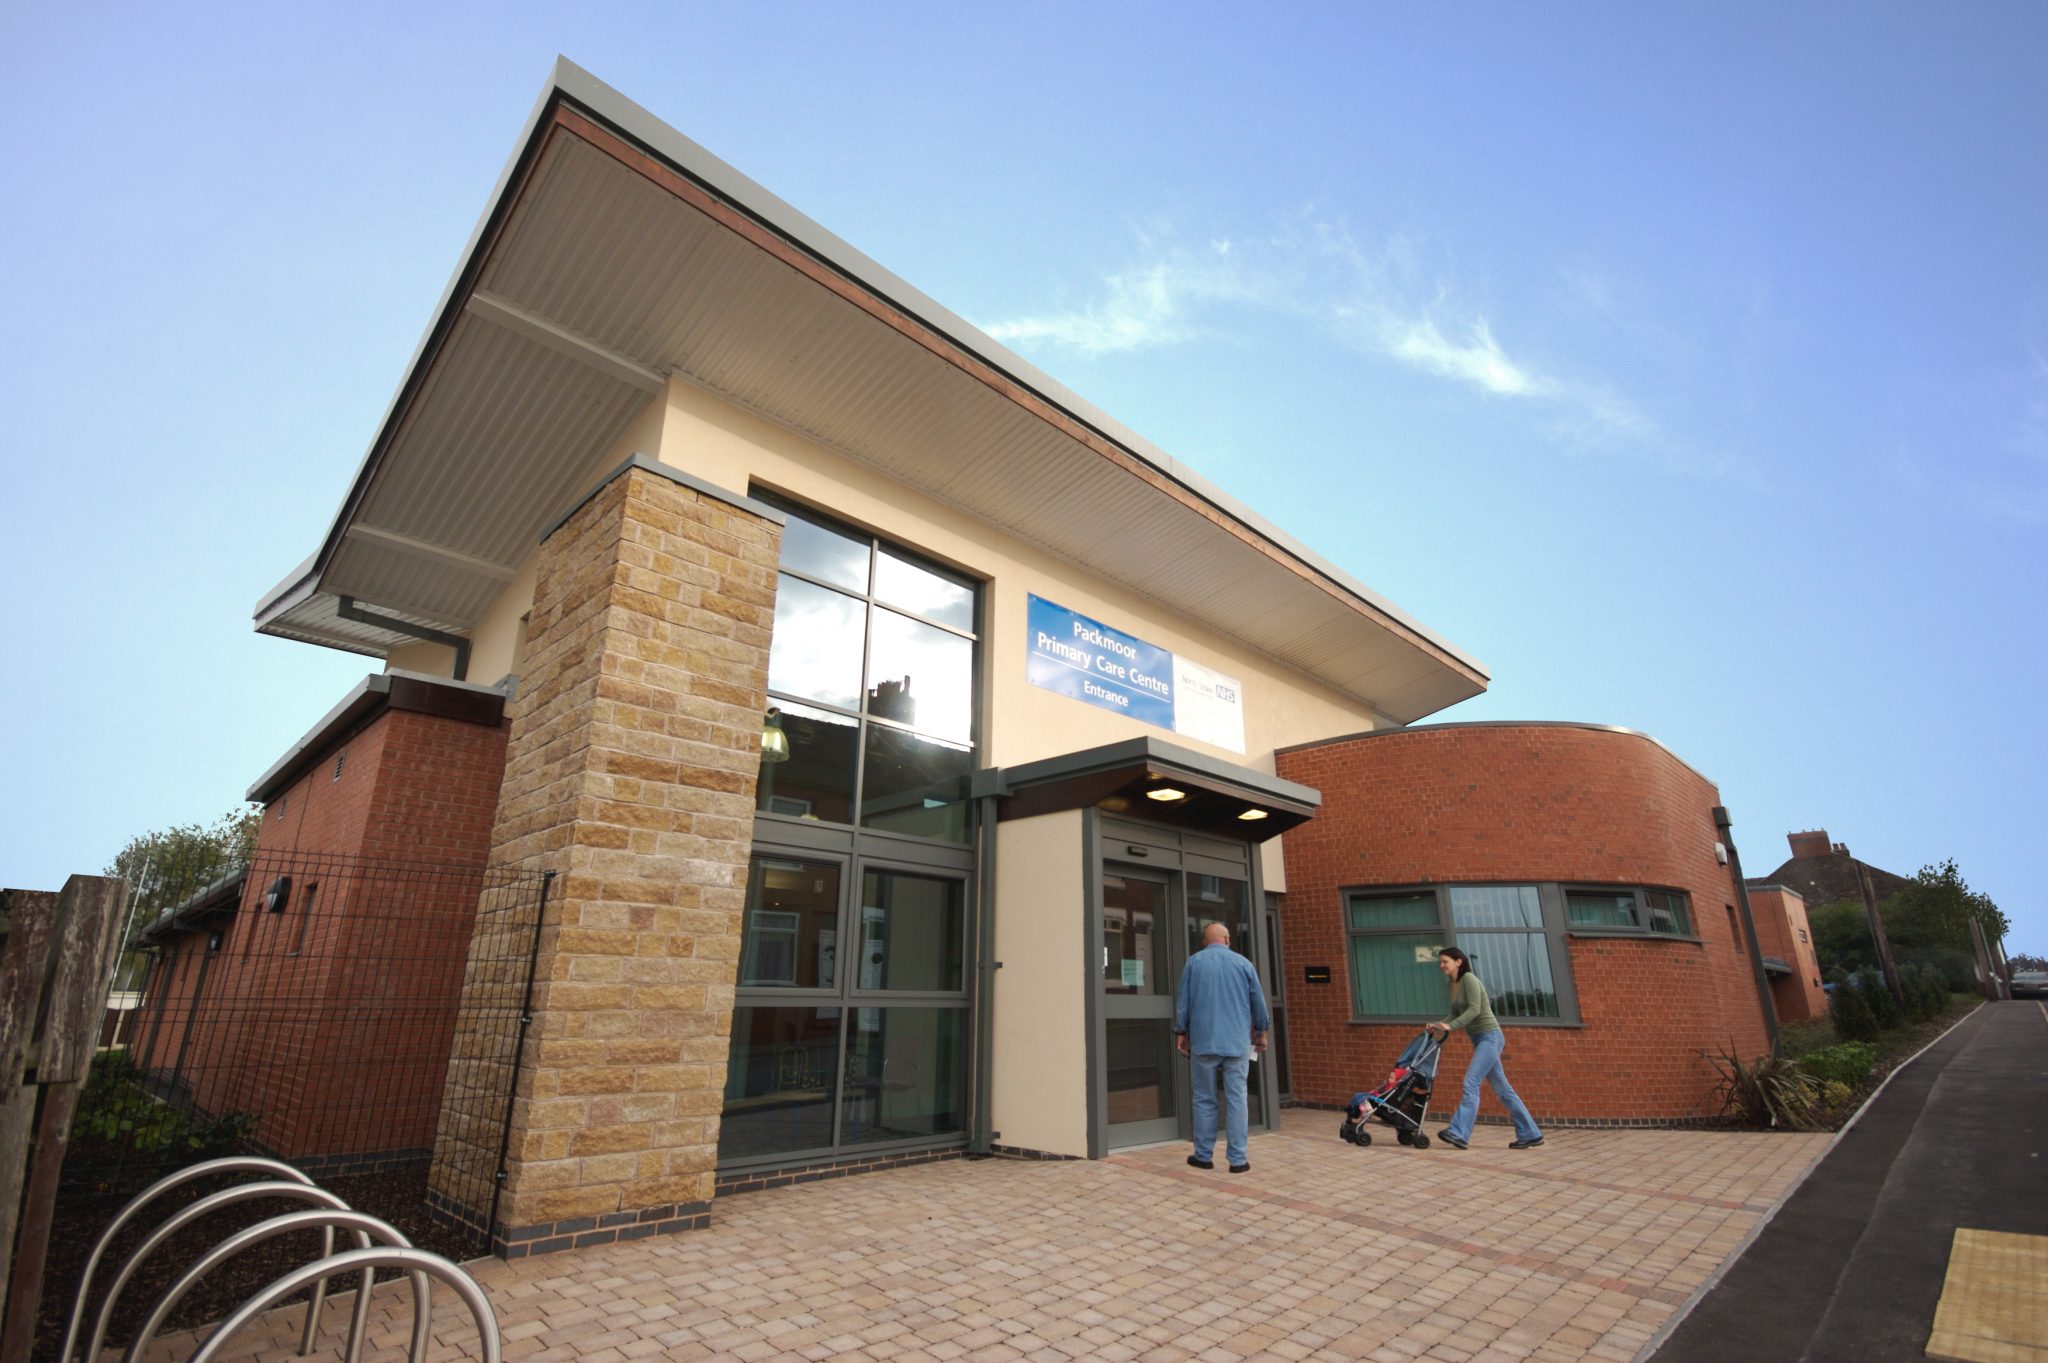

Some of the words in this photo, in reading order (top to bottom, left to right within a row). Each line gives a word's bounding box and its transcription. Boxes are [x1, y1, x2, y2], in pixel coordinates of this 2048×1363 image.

[1074, 621, 1137, 660] Packmoor
[1039, 632, 1091, 669] Primary
[1096, 655, 1125, 679] Care
[1129, 668, 1168, 695] Centre
[1084, 681, 1129, 707] Entrance
[1217, 685, 1235, 703] NHS
